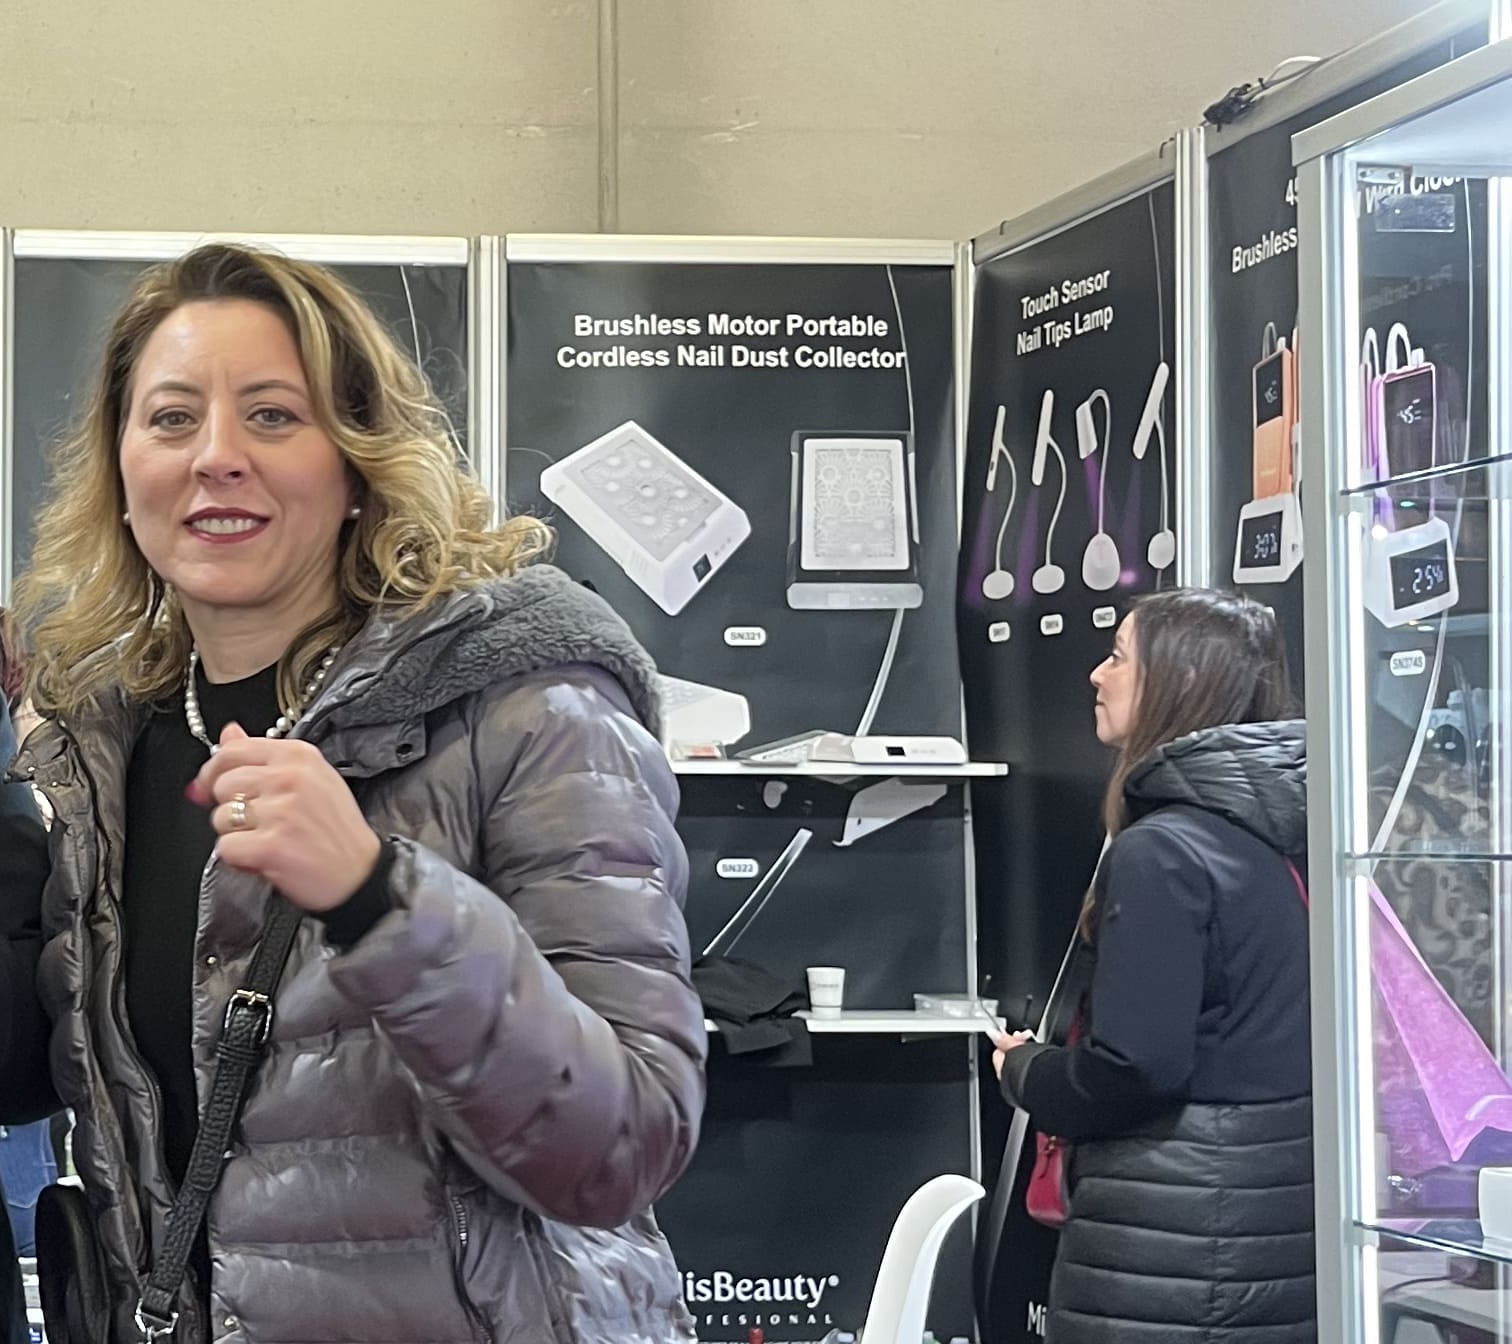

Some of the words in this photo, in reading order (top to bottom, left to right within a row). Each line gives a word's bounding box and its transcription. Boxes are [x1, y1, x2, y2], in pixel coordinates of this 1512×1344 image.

[1232, 226, 1299, 274] Brushless
[1021, 286, 1059, 319] Touch
[1061, 270, 1111, 304] Sensor
[574, 313, 702, 337] Brushless
[708, 313, 781, 336] Motor
[786, 314, 888, 337] Portable
[1017, 326, 1042, 355] Nail
[1043, 320, 1072, 347] Tips
[1074, 305, 1114, 331] Lamp
[556, 345, 671, 368] Cordless
[677, 344, 724, 367] Nail
[731, 345, 789, 368] Dust
[794, 346, 906, 369] Collector
[678, 1271, 827, 1308] isBeauty
